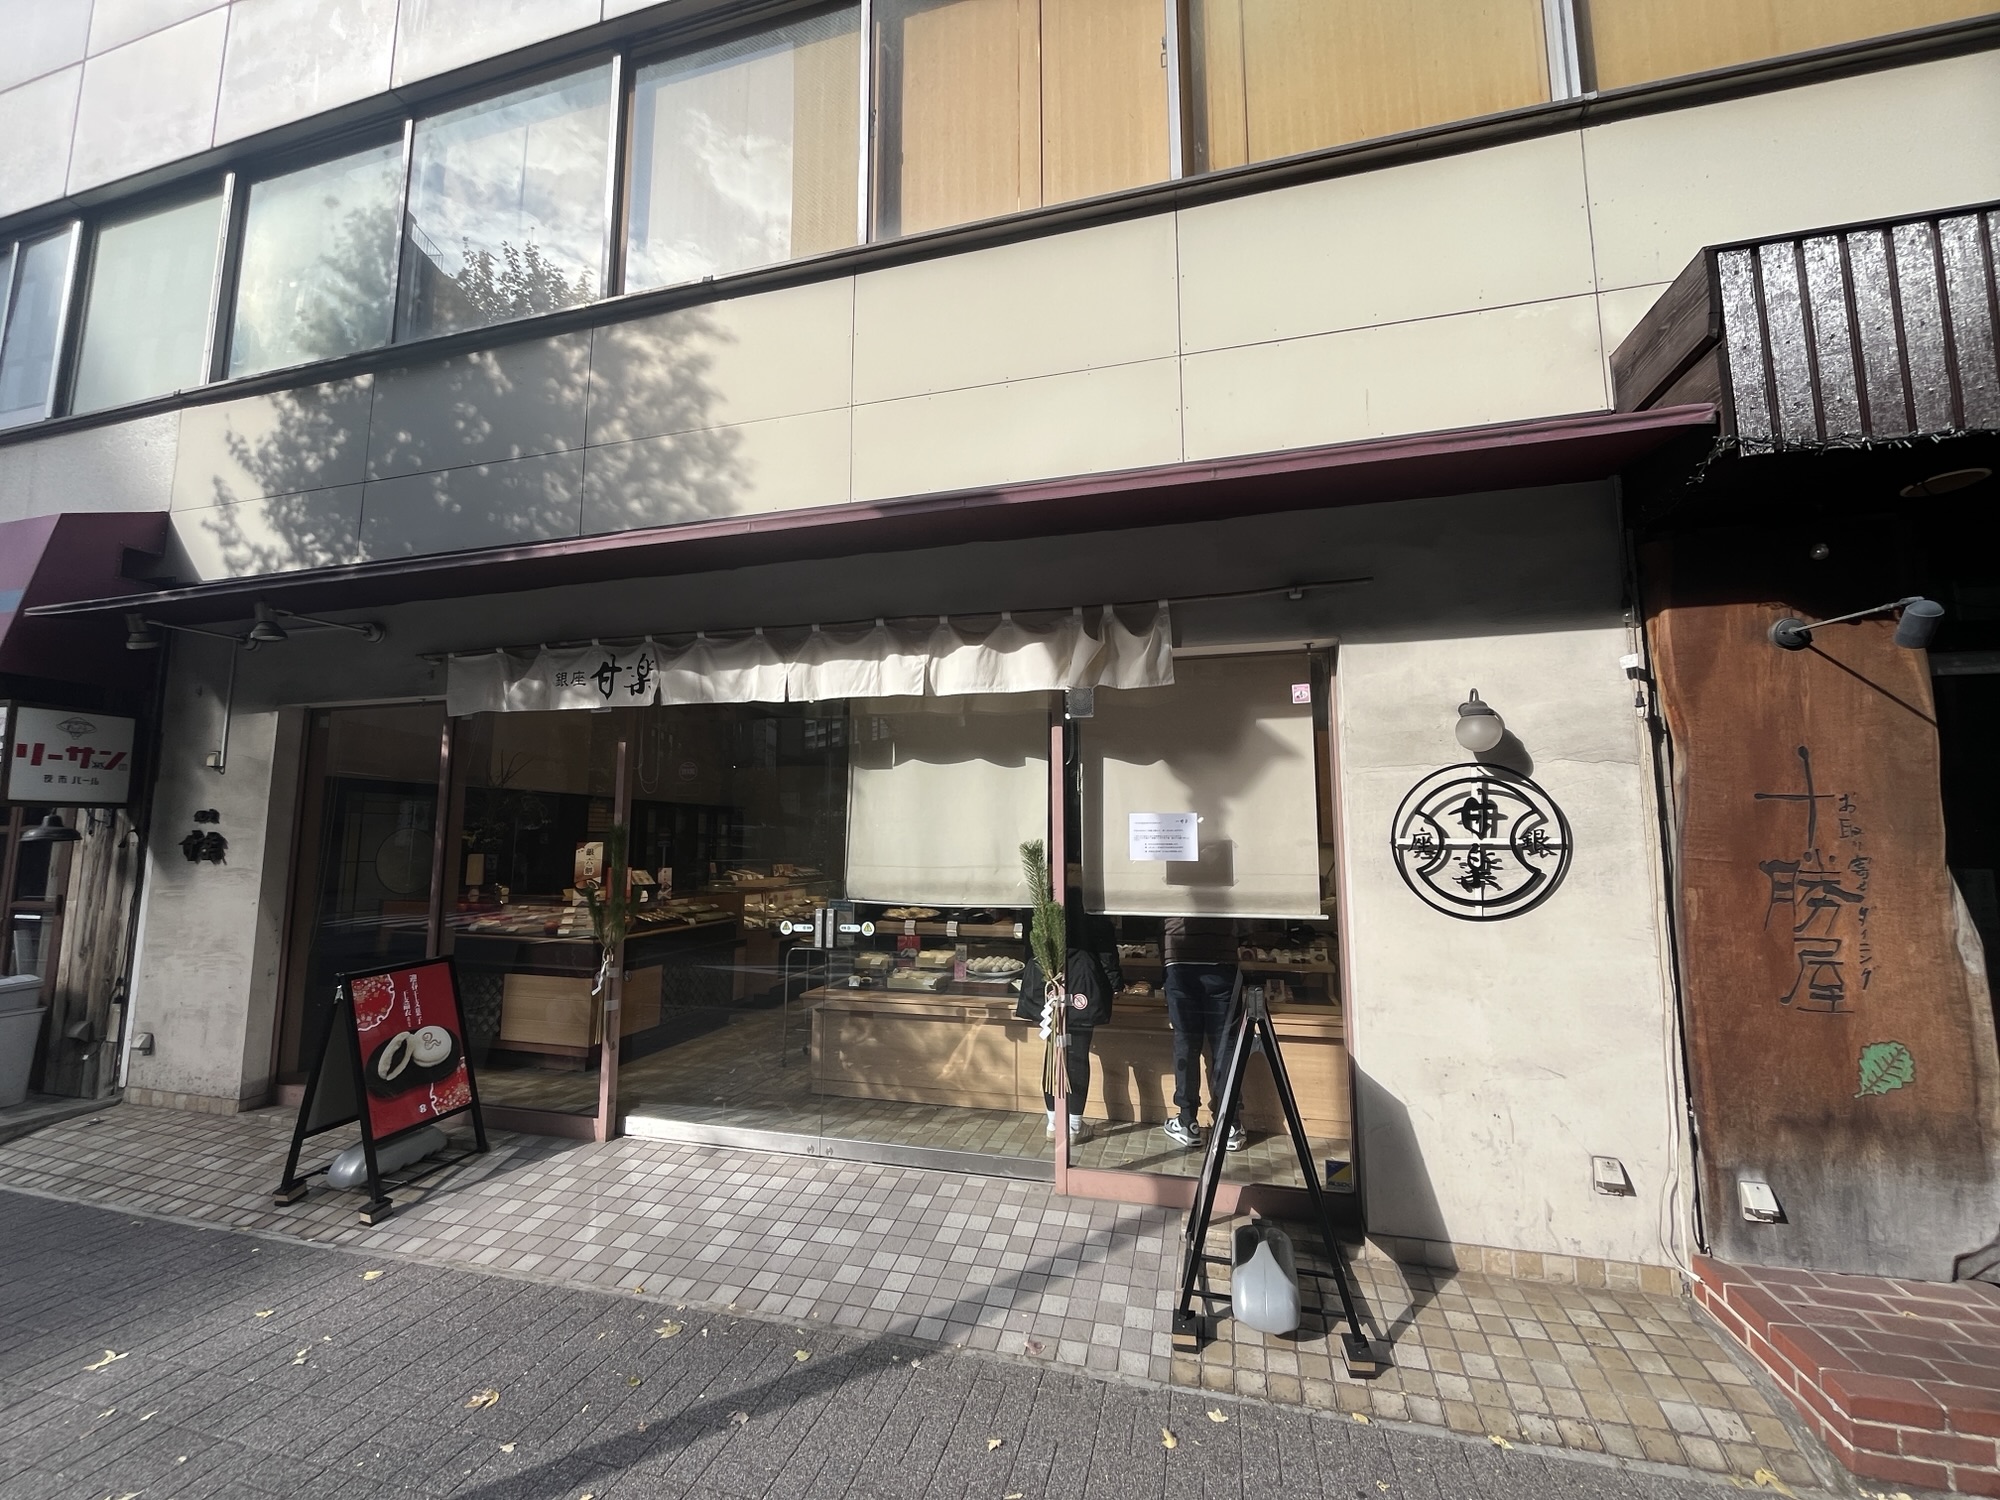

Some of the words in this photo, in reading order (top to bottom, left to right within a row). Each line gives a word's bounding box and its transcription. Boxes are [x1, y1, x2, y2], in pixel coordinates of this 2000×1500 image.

[15, 743, 128, 770] リーサン
[1754, 745, 1865, 1015] 十勝屋
